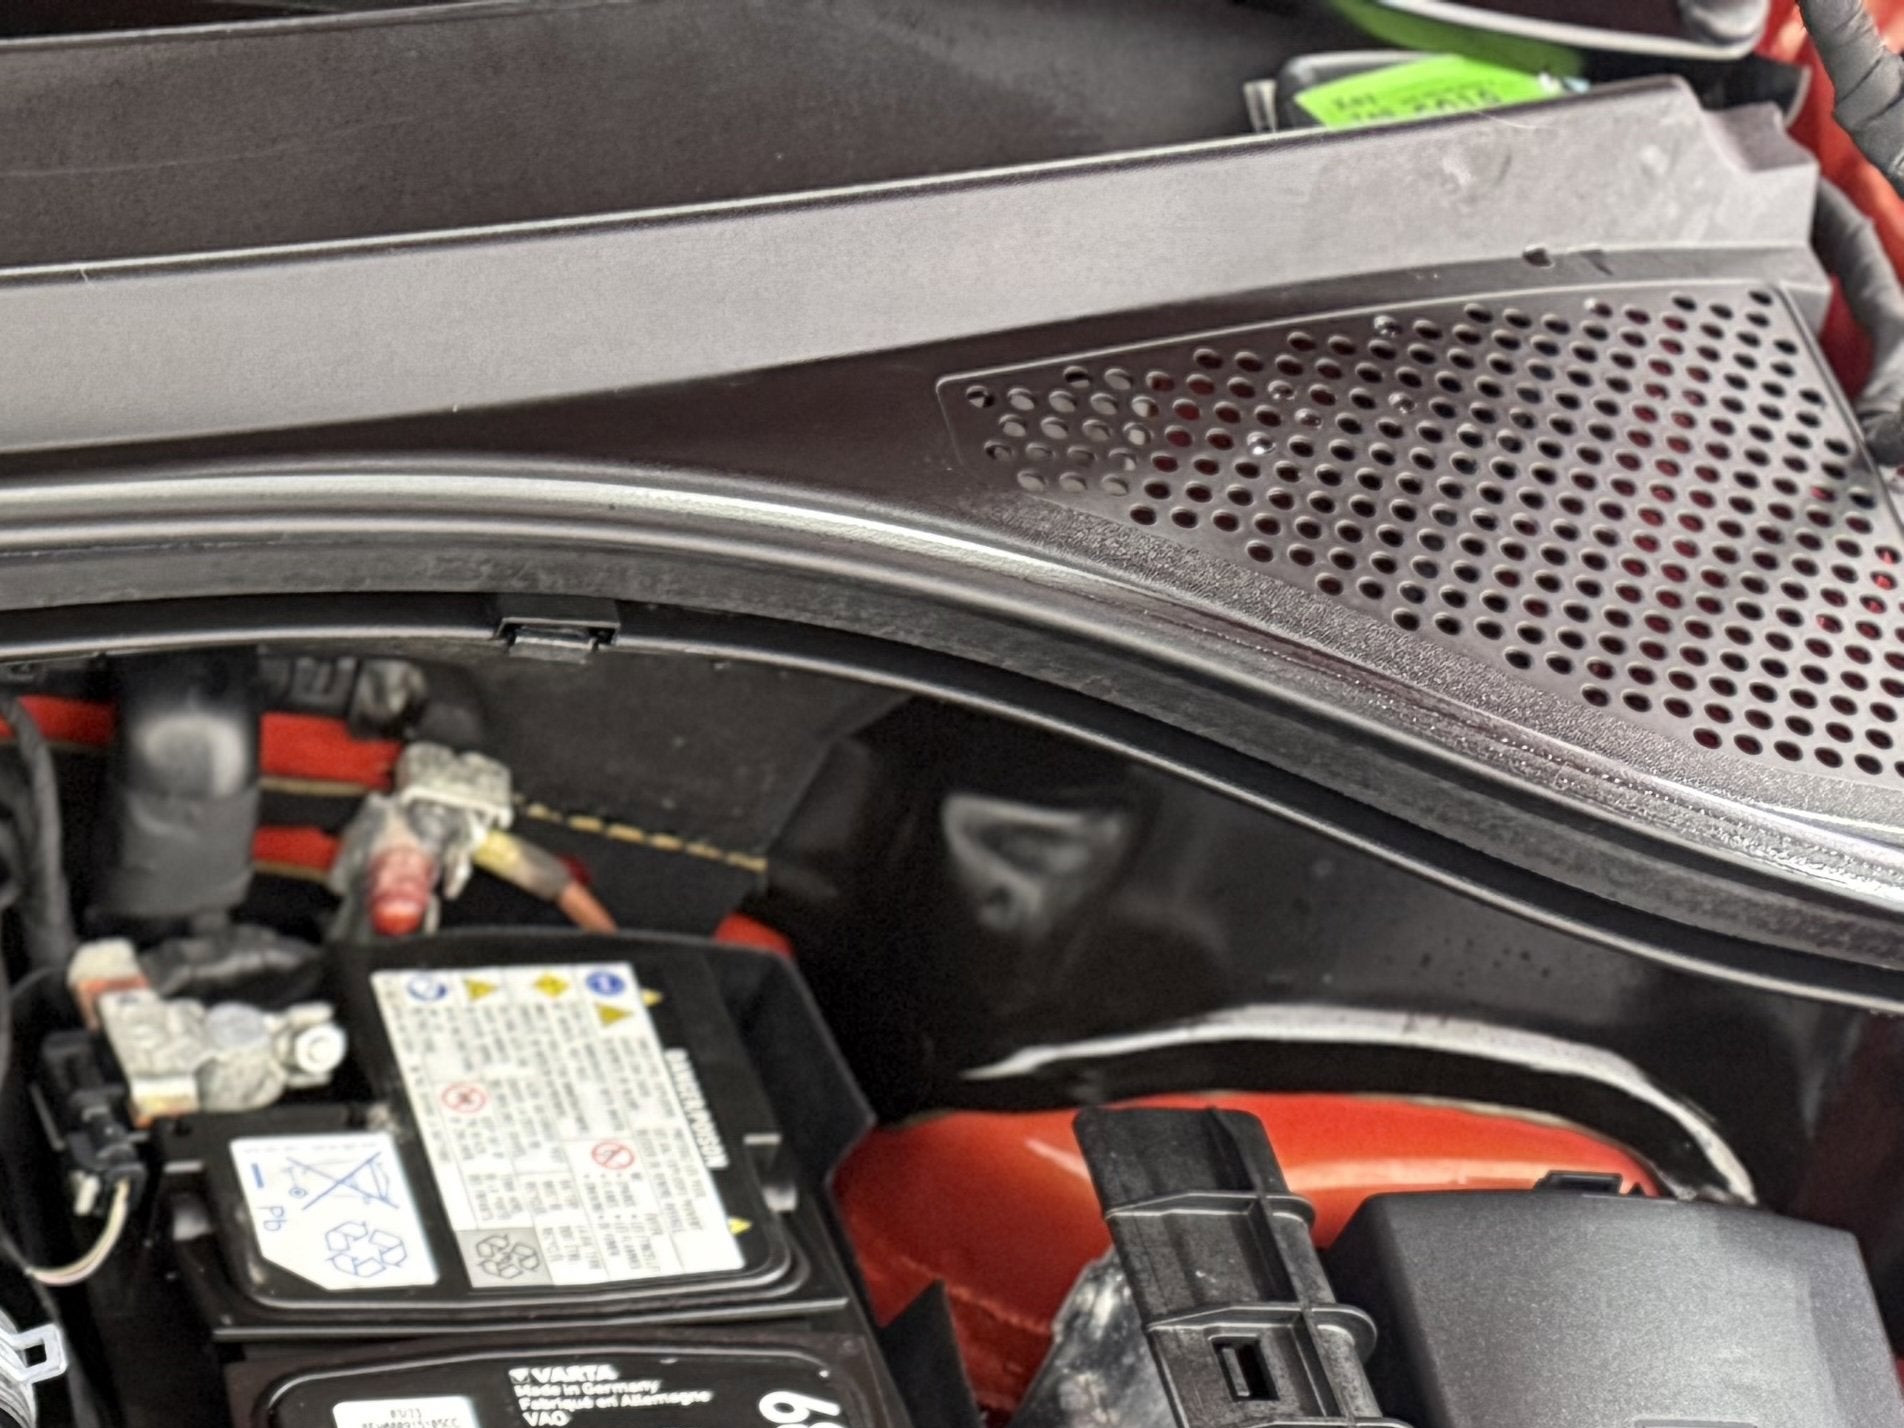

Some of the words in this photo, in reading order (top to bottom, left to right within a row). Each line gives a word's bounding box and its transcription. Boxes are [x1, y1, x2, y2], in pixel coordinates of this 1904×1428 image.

[531, 1365, 619, 1384] VARTA
[514, 1384, 561, 1398] Made
[564, 1384, 580, 1396] in
[582, 1380, 661, 1395] Germany
[596, 1395, 617, 1408] en
[621, 1391, 712, 1406] Allemagne
